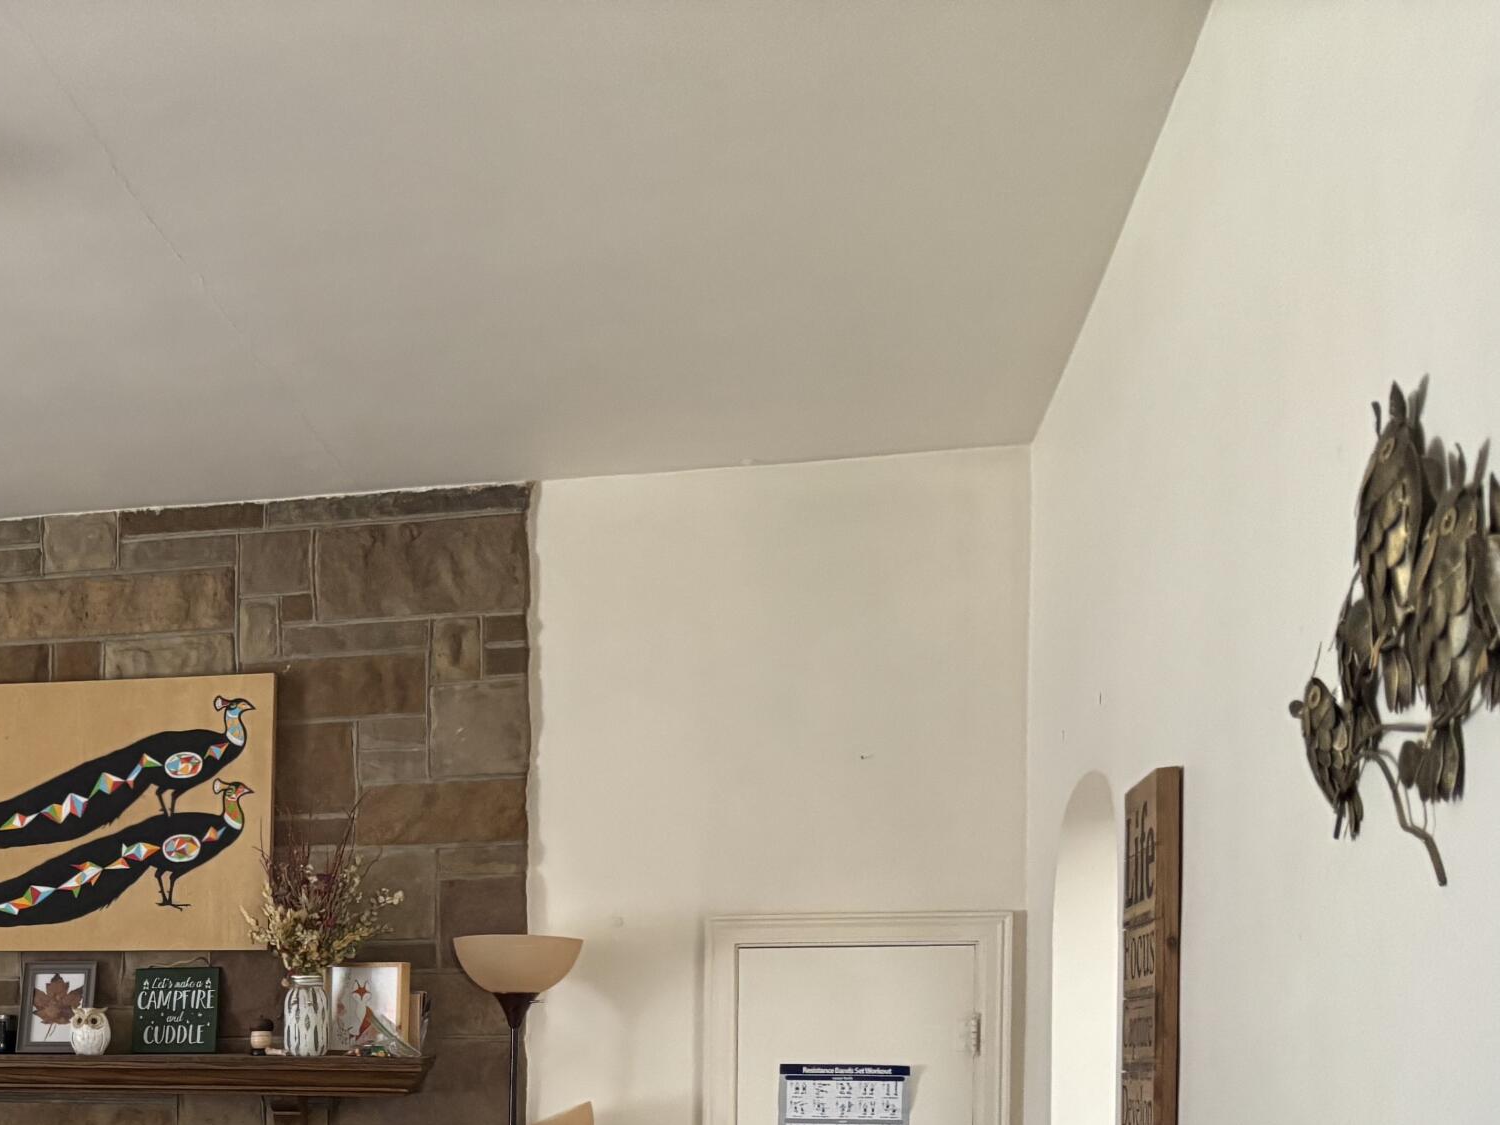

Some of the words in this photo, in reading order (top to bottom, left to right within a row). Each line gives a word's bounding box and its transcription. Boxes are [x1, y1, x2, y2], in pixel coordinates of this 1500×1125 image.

[1124, 801, 1156, 909] Life
[151, 977, 173, 989] Let's
[137, 989, 216, 1012] CAMPFIRE
[166, 1010, 185, 1023] and
[143, 1024, 205, 1045] CUDDLE
